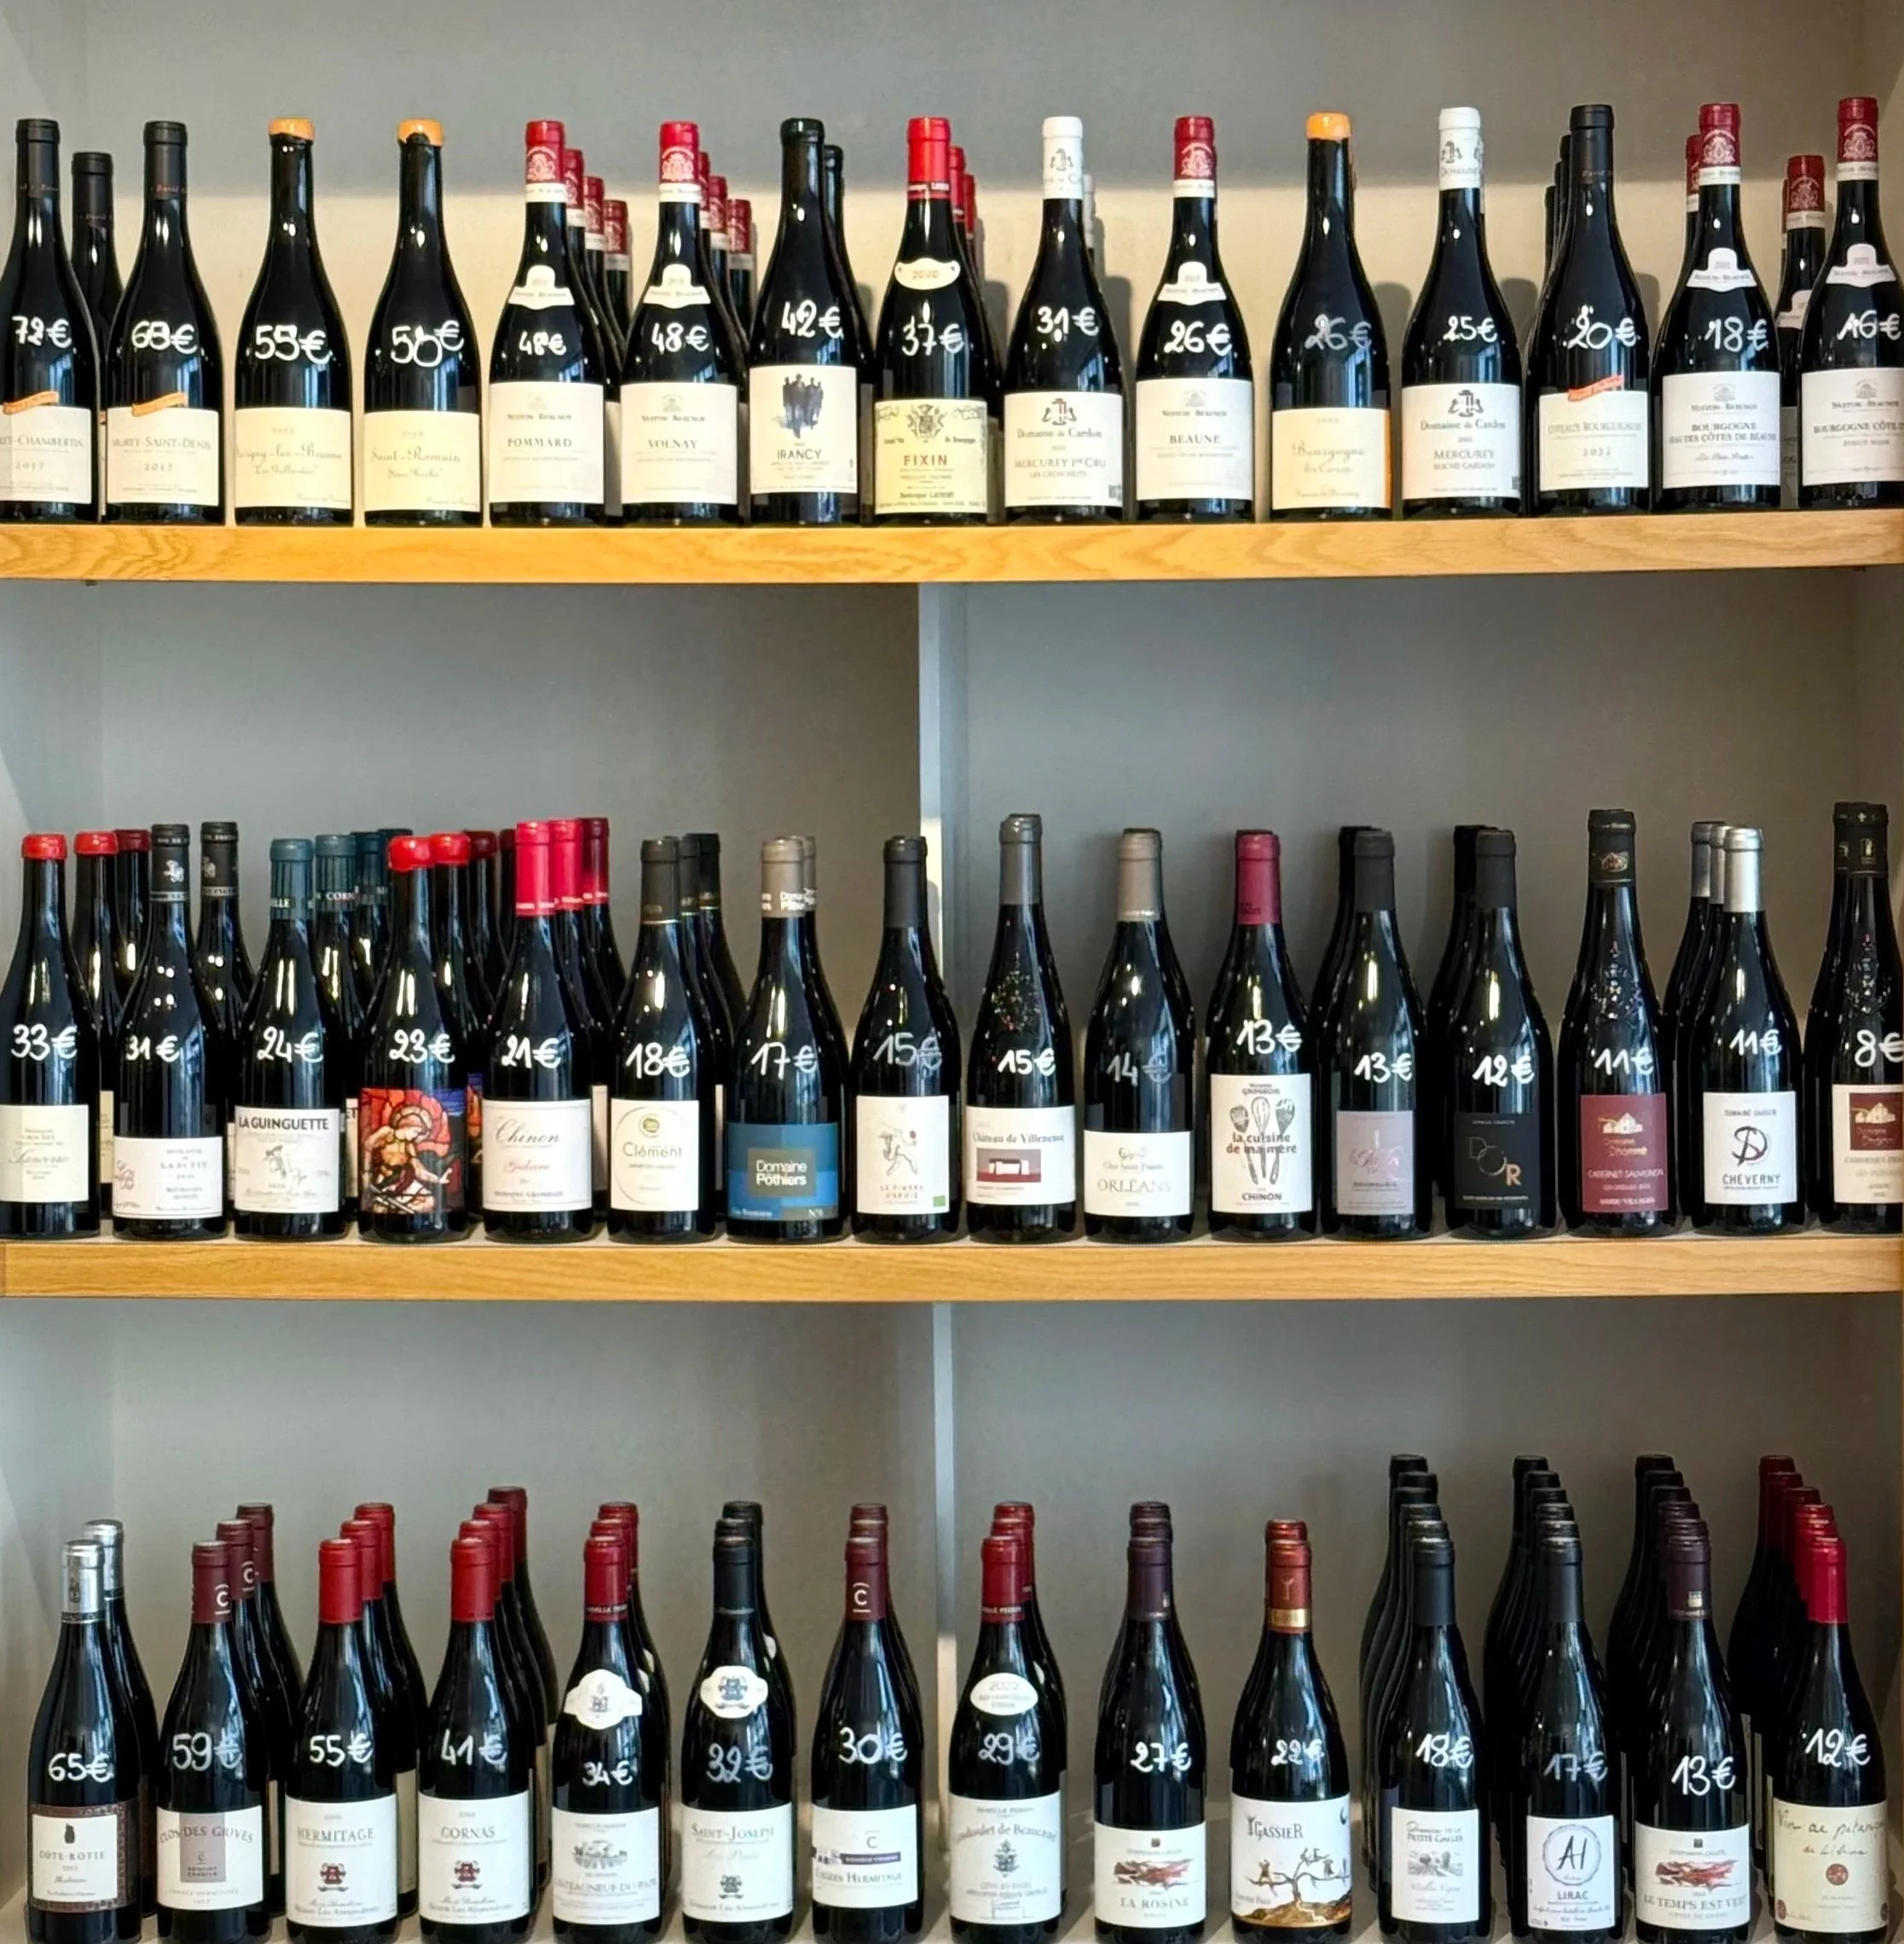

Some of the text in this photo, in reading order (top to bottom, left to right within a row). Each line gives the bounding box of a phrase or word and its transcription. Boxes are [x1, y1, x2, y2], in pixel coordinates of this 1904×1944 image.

[11, 315, 72, 349] 72€
[782, 300, 842, 338] 42€
[1037, 306, 1098, 336] 31€
[1443, 316, 1497, 342] 25€
[1704, 316, 1768, 352] 18€
[651, 322, 709, 352] 48€
[902, 315, 964, 356] 37€
[1164, 320, 1231, 356] 26€
[507, 437, 572, 448] POMMARD
[648, 439, 697, 449] VOLNAY
[1170, 435, 1221, 444] BEAUNE
[777, 449, 823, 461] IRANCY
[903, 454, 948, 466] FIXIN
[11, 1024, 78, 1061] 33€
[126, 1035, 180, 1062] 31€
[257, 1027, 323, 1062] 24€
[389, 1028, 455, 1063] 23€
[501, 1035, 561, 1068] 21€
[872, 1032, 942, 1070] 15€
[1236, 1020, 1303, 1055] 13€
[1730, 1028, 1782, 1056] 11€
[1854, 1029, 1904, 1067] 8€
[625, 1042, 690, 1079] 18€
[750, 1042, 817, 1080] 17€
[998, 1048, 1056, 1076] 15€
[1354, 1052, 1412, 1083] 13€
[1472, 1055, 1534, 1087] 12€
[1594, 1048, 1654, 1076] 11€
[239, 1115, 329, 1131] LA GUINGUETTE
[495, 1118, 561, 1143] Chinon
[1006, 1133, 1017, 1143] de
[1232, 1131, 1290, 1143] la cuisine
[622, 1142, 682, 1158] Clément
[1226, 1143, 1240, 1154] de
[1266, 1143, 1297, 1154] mère
[756, 1160, 807, 1173] Domaine
[756, 1172, 807, 1186] Pothiers
[1722, 1173, 1780, 1185] CHEVERNY
[1241, 1192, 1282, 1202] CHINON
[172, 1732, 243, 1771] 59€
[310, 1734, 373, 1767] 55€
[441, 1729, 507, 1766] 41€
[839, 1727, 908, 1764] 30€
[978, 1733, 1039, 1766] 29€
[1131, 1742, 1192, 1773] 27€
[1415, 1733, 1473, 1768] 18€
[1805, 1728, 1871, 1767] 12€
[49, 1753, 114, 1783] 65€
[1544, 1751, 1607, 1782] 17€
[1671, 1755, 1736, 1796] 13€
[183, 1826, 207, 1837] DES
[211, 1826, 253, 1843] GRIVES
[298, 1827, 373, 1843] HERMITAGE
[441, 1826, 495, 1839] CORNAS
[998, 1822, 1011, 1834] de
[1120, 1897, 1189, 1909] LA ROSINE
[1557, 1890, 1589, 1901] LIRAC
[1658, 1898, 1697, 1910] TEMPS
[1700, 1897, 1721, 1910] EST
